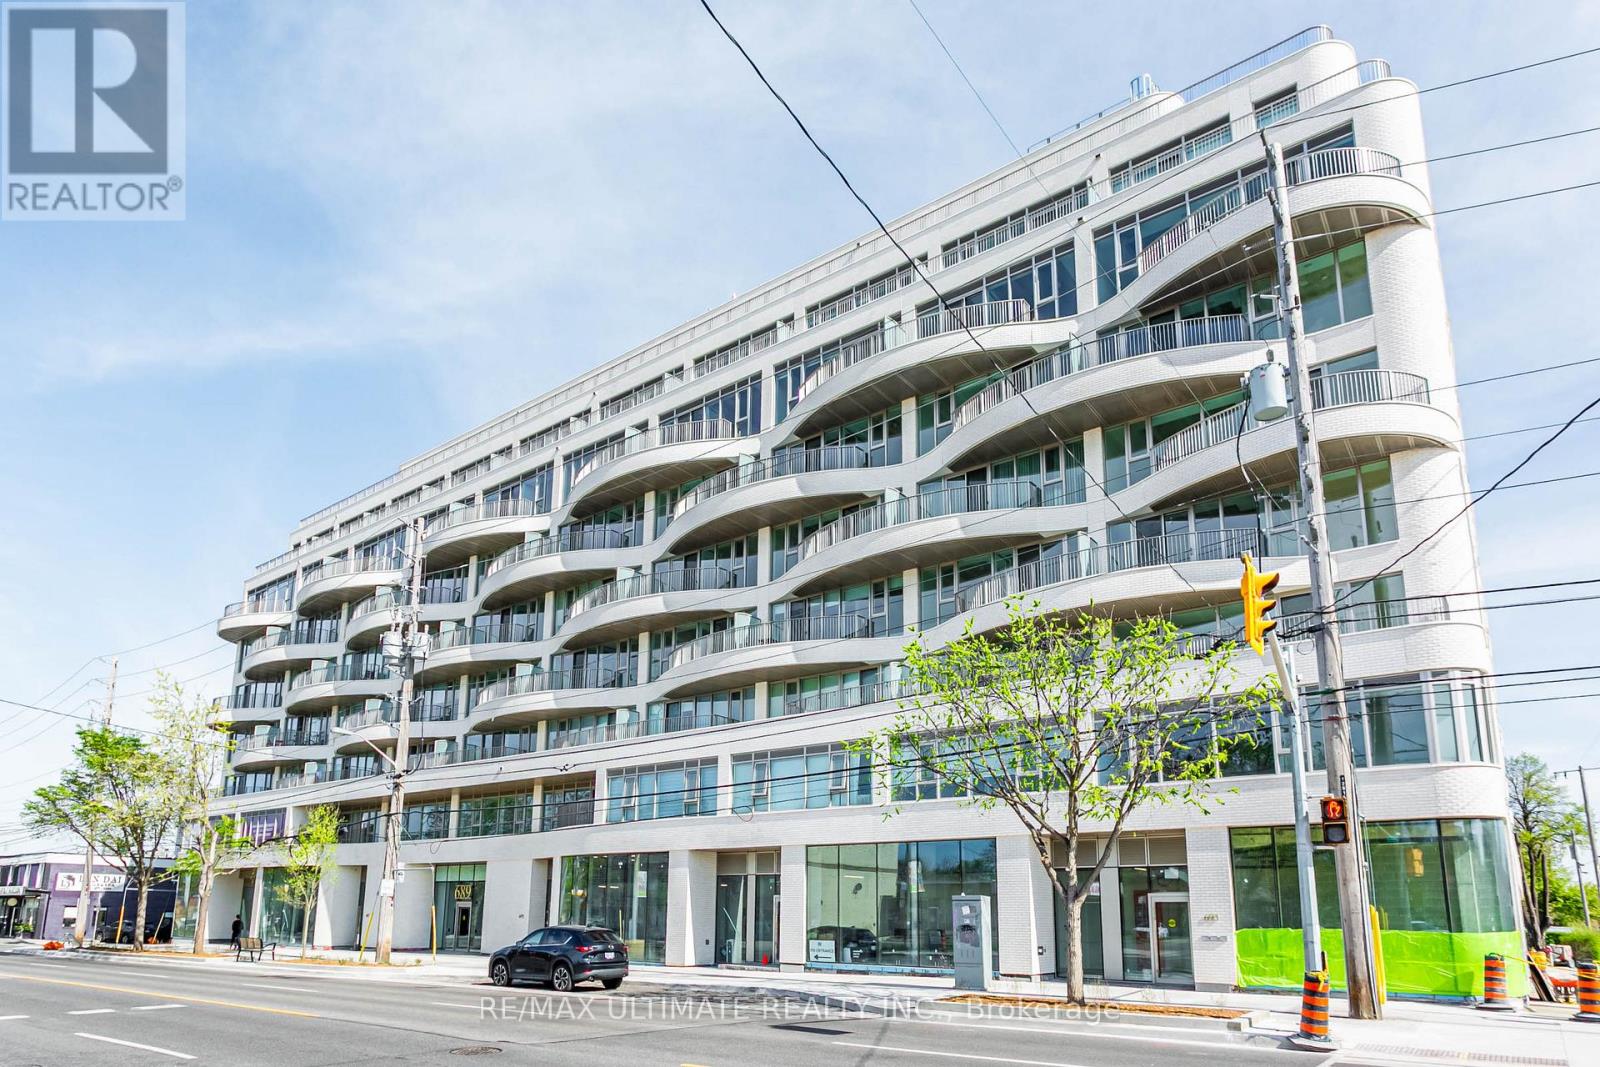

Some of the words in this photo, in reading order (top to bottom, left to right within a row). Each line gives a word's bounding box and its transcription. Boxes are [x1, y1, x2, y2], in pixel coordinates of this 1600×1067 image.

[79, 874, 101, 883] LN
[103, 875, 122, 884] DAI
[454, 885, 472, 899] 689
